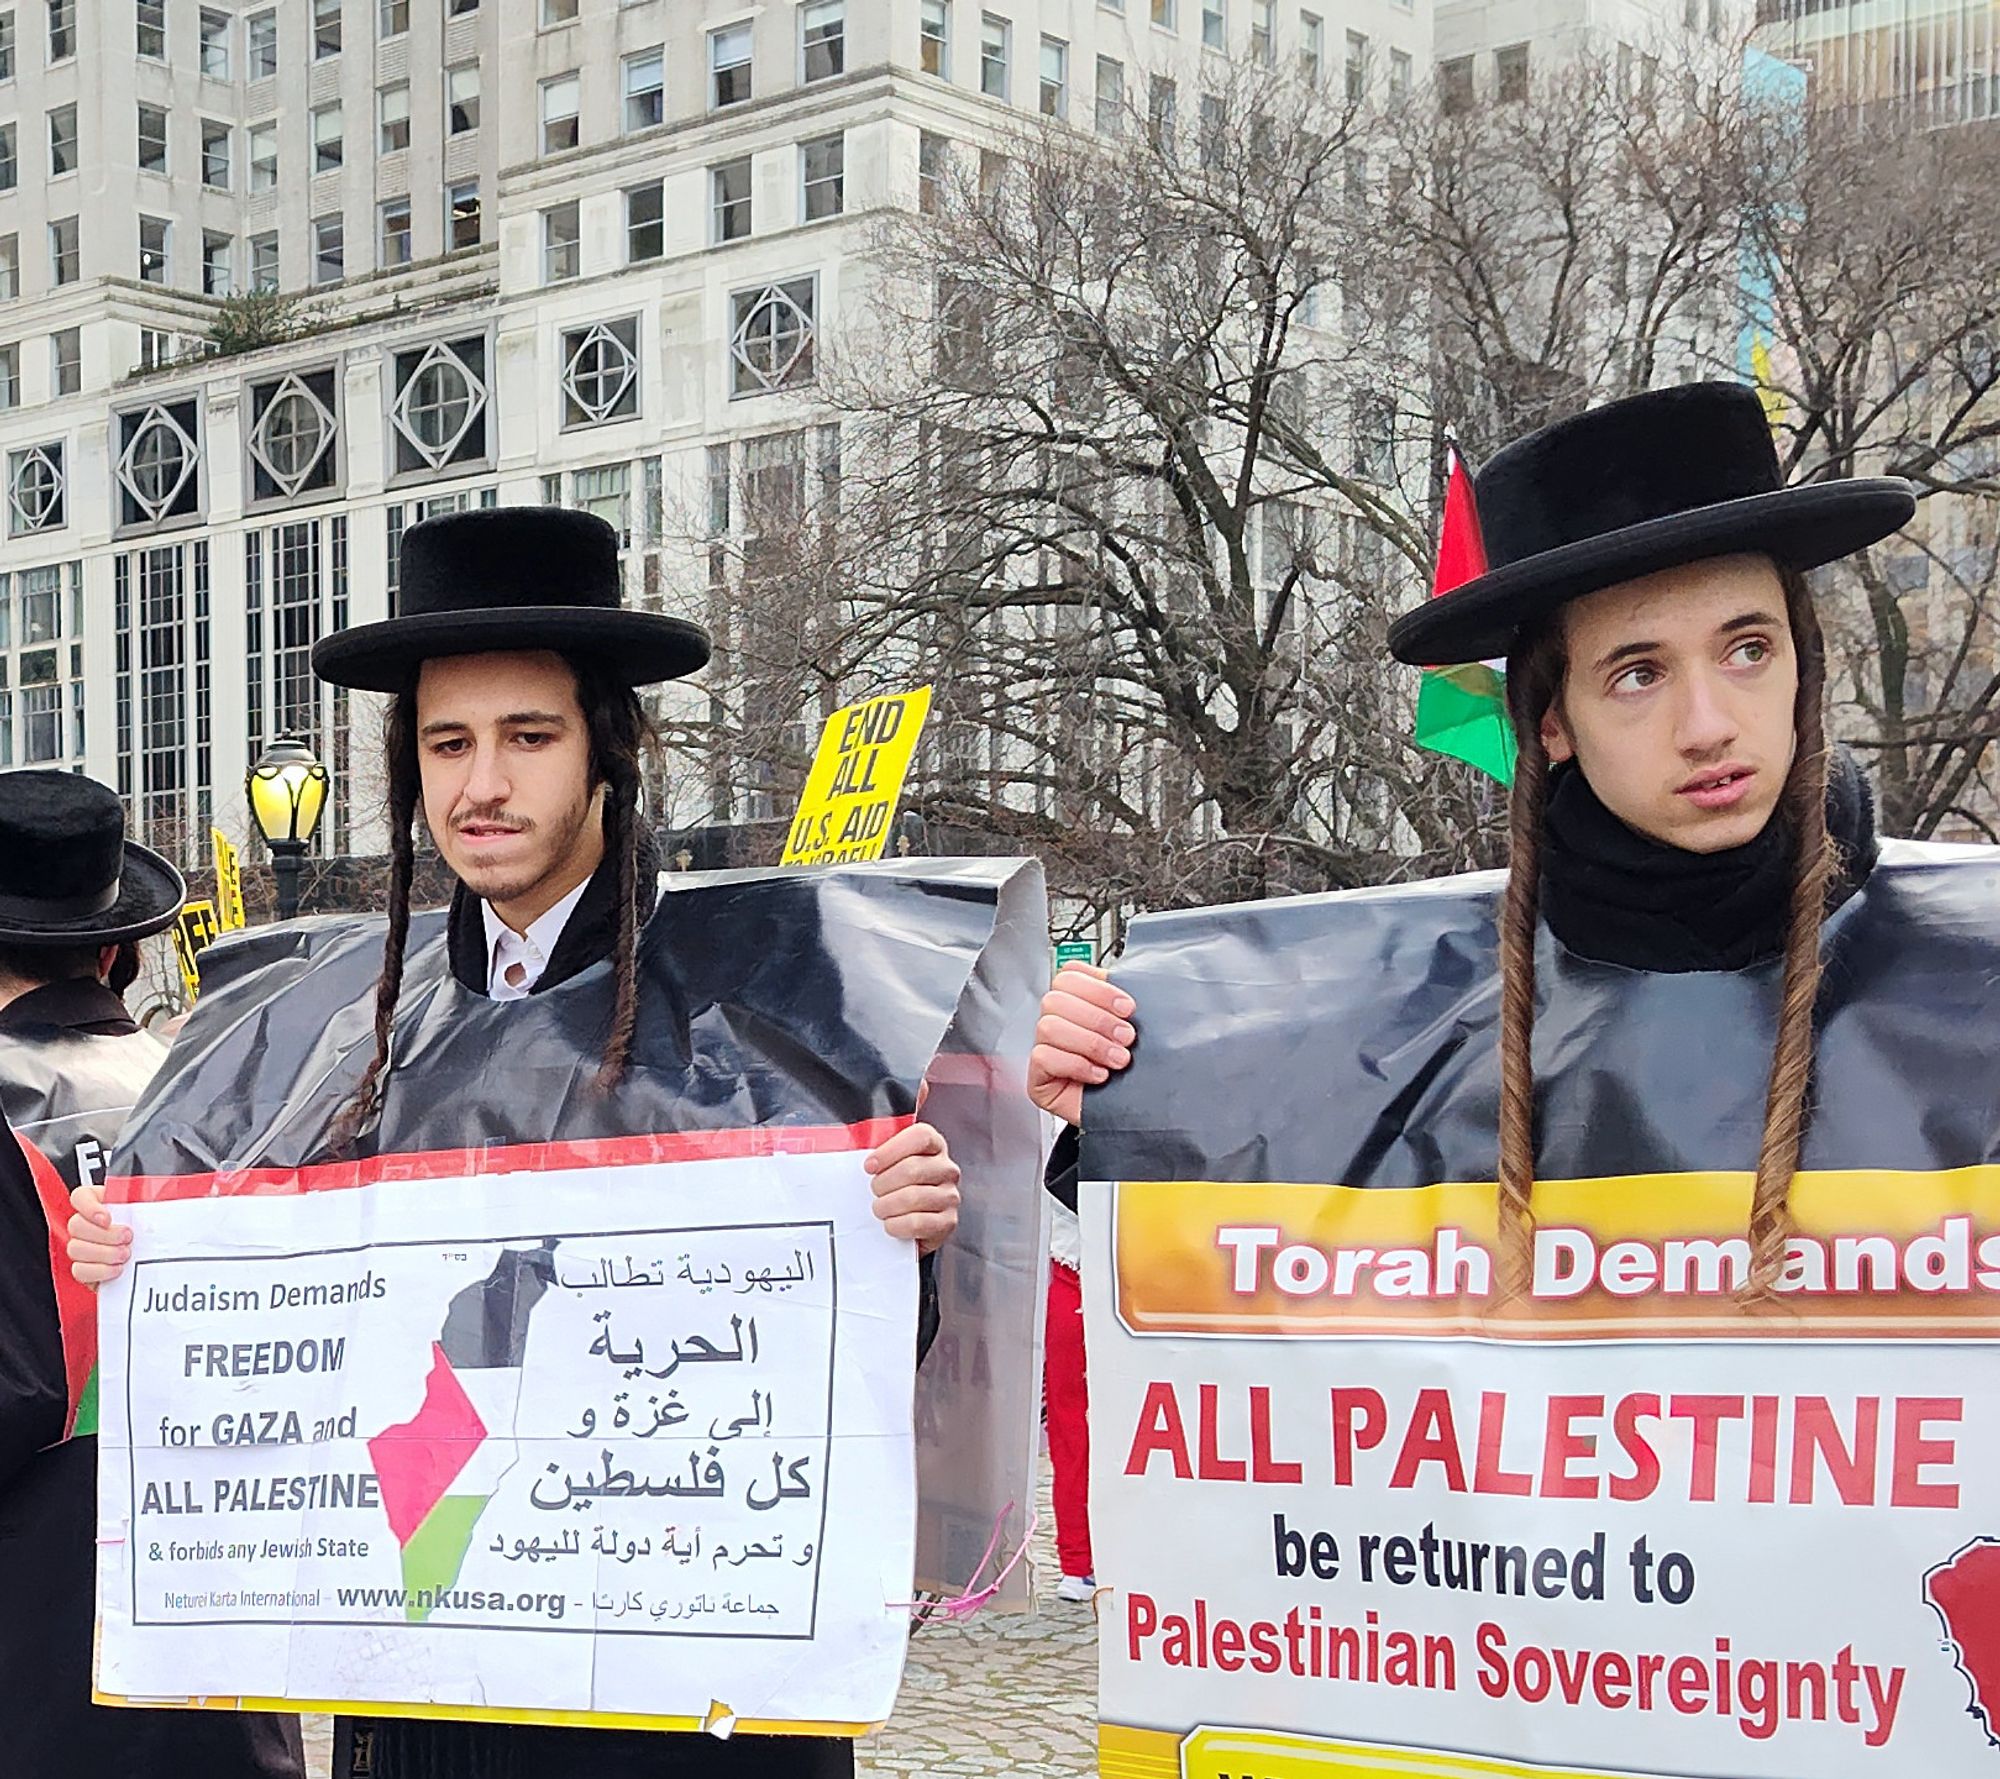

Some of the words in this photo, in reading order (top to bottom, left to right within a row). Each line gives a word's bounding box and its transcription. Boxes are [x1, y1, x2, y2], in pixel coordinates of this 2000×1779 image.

[839, 700, 906, 754] END
[826, 749, 879, 801] ALL
[838, 801, 889, 844] AID
[561, 1255, 664, 1298] تطالب
[1216, 1225, 1493, 1298] Torah
[144, 1284, 260, 1313] Judaism
[270, 1270, 386, 1309] Demands
[184, 1337, 345, 1377] FREEDOM
[589, 1310, 758, 1380] الحرية
[160, 1416, 201, 1447] for
[212, 1411, 303, 1446] GAZA
[313, 1406, 357, 1441] and
[567, 1408, 596, 1438] و
[614, 1390, 689, 1437] غزة
[709, 1389, 772, 1440] إلى
[1125, 1382, 1301, 1485] ALL
[1332, 1387, 1963, 1508] PALESTINE
[141, 1481, 203, 1514] ALL
[214, 1474, 379, 1512] PALESTINE
[530, 1446, 724, 1512] فلسطين
[747, 1452, 810, 1510] كل
[149, 1542, 163, 1561] &
[169, 1540, 223, 1561] forbids
[228, 1544, 257, 1562] any
[260, 1538, 312, 1558] Jewish
[317, 1537, 369, 1557] State
[489, 1529, 580, 1563] لليهود
[591, 1526, 651, 1563] دولة
[712, 1535, 783, 1570] تحرم
[792, 1542, 813, 1566] و
[1275, 1514, 1338, 1580] be
[1360, 1522, 1605, 1600] returned
[1630, 1534, 1696, 1604] to
[164, 1592, 207, 1609] Neturei
[210, 1592, 237, 1607] Karta
[240, 1589, 320, 1607] International
[338, 1586, 566, 1619] www.nkusa.org
[1127, 1593, 1456, 1692] Palestinian
[1477, 1622, 1906, 1747] Sovereignty
